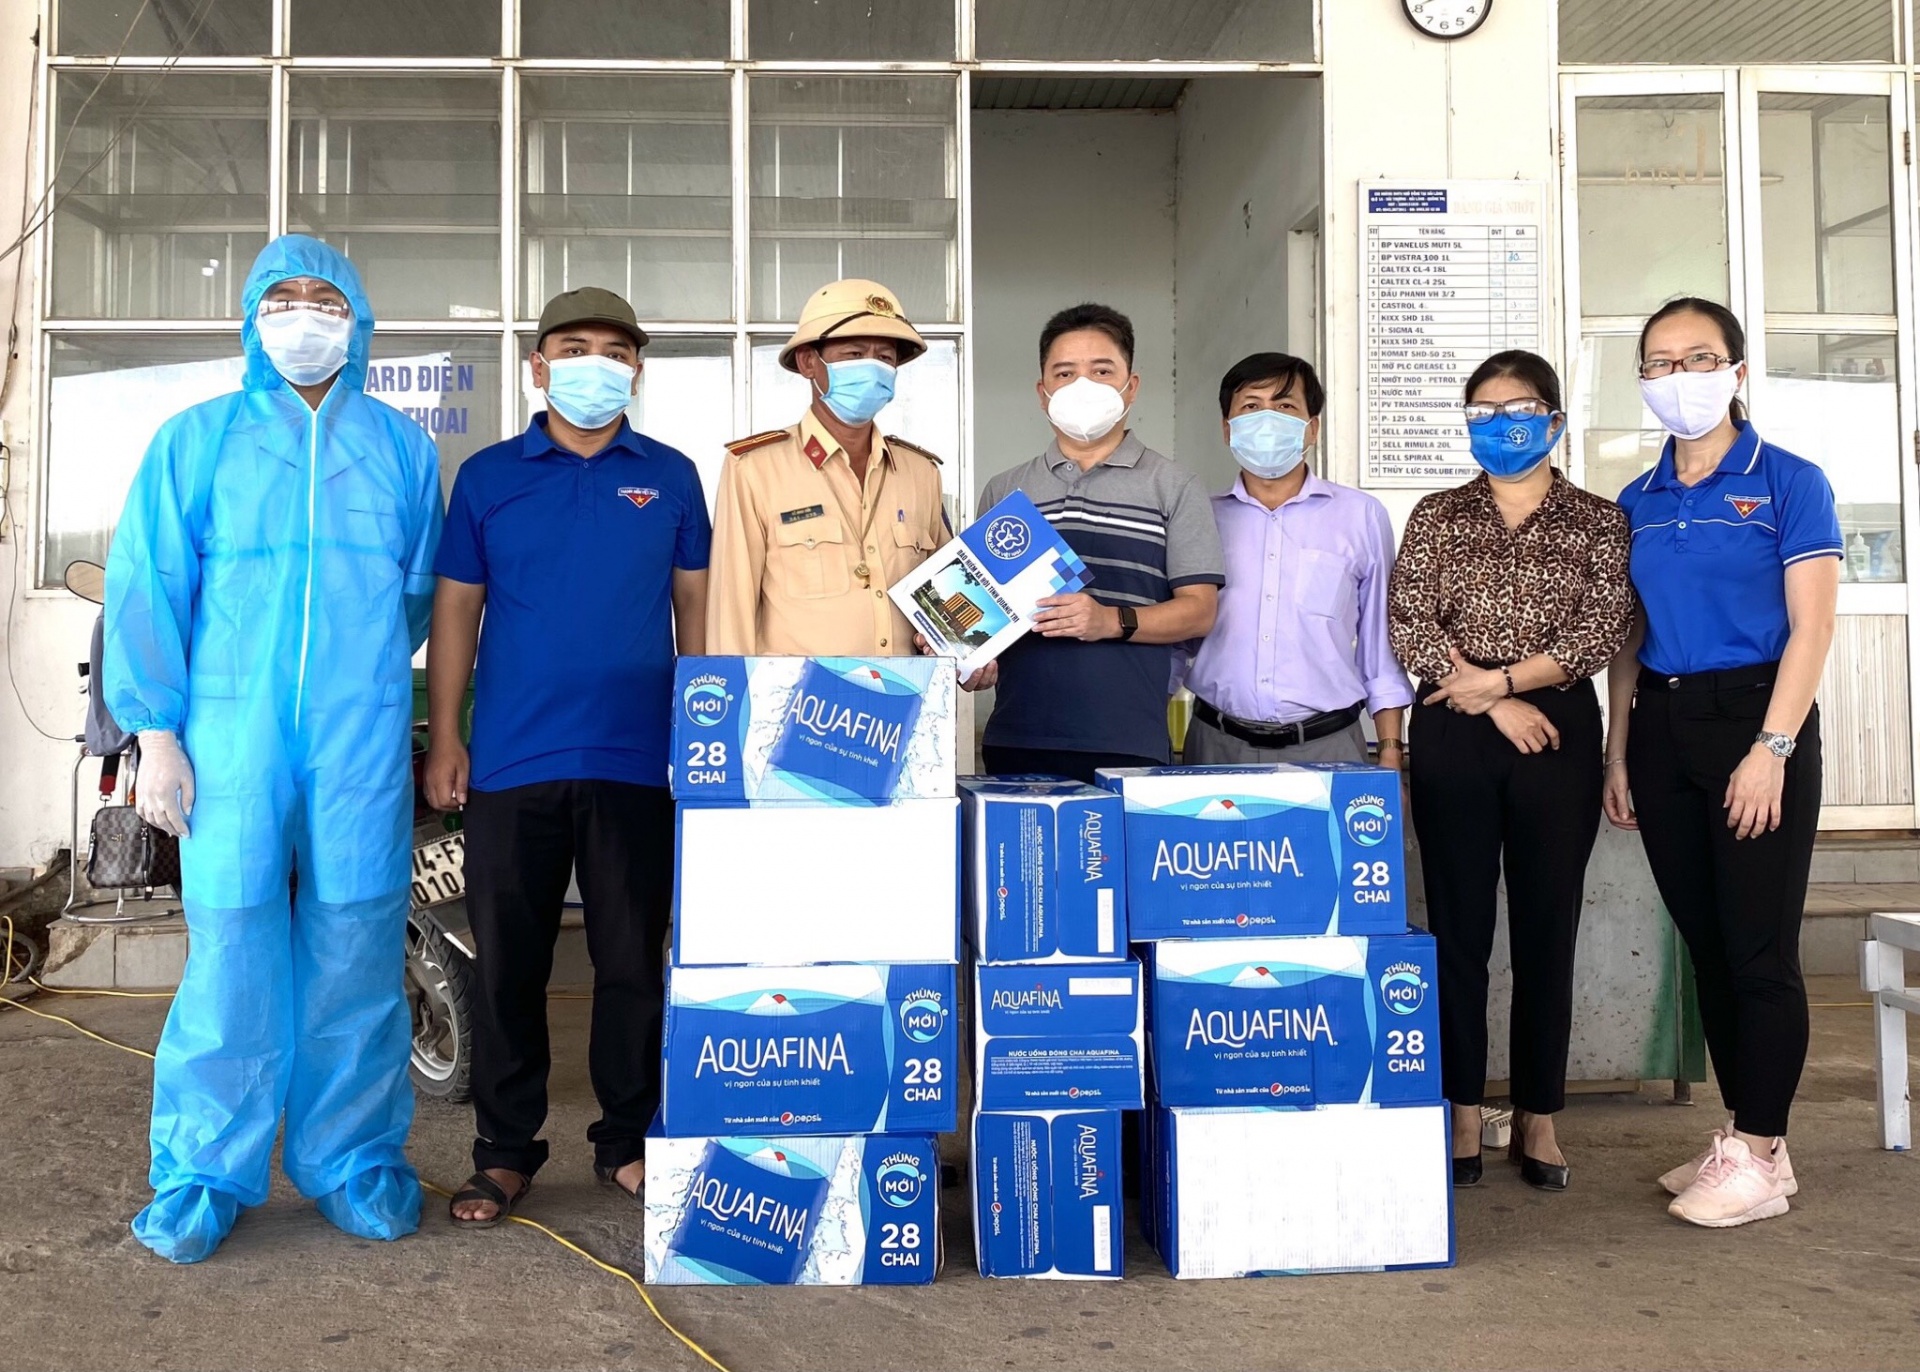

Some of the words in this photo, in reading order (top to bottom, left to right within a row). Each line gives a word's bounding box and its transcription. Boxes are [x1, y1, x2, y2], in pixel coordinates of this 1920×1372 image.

[1414, 4, 1423, 13] 8
[1466, 6, 1475, 14] 4
[1425, 16, 1434, 24] 7
[1439, 21, 1449, 29] 6
[1455, 17, 1465, 26] 5
[366, 366, 412, 392] ARD
[690, 673, 727, 688] THÙNG
[692, 698, 721, 712] MỚI
[784, 689, 903, 763] AQUAFINA
[687, 741, 727, 766] 28
[688, 770, 726, 784] CHAI
[1349, 792, 1385, 808] THÙNG
[1353, 819, 1381, 832] MỚI
[1083, 809, 1103, 883] AQUAFINA
[1152, 836, 1304, 881] AQUAFINA
[1352, 861, 1390, 887] 28
[1189, 883, 1209, 891] ngon
[1211, 881, 1225, 890] của
[1354, 890, 1390, 904] CHAI
[1249, 915, 1276, 925] pepsi
[1385, 960, 1422, 976] THÙNG
[905, 987, 942, 1004] THÙNG
[991, 989, 1063, 1010] AQUAFINA
[1389, 986, 1417, 1000] MỚI
[908, 1014, 936, 1028] MỚI
[1185, 1004, 1338, 1050] AQUAFINA
[1386, 1030, 1425, 1055] 28
[695, 1033, 854, 1078] AQUAFINA
[1223, 1052, 1243, 1060] ngon
[1245, 1050, 1259, 1058] của
[903, 1058, 942, 1084] 28
[1388, 1058, 1425, 1073] CHAI
[756, 1078, 771, 1087] của
[1283, 1084, 1310, 1094] pepsi
[903, 1088, 941, 1102] CHAI
[794, 1114, 821, 1123] pepsi
[882, 1151, 920, 1167] THÙNG
[1077, 1123, 1099, 1201] AQUAFINA
[885, 1178, 914, 1193] MỚI
[685, 1171, 808, 1250] AQUAFINA
[707, 1221, 725, 1233] ngon
[726, 1228, 741, 1239] của
[880, 1223, 920, 1249] 28
[880, 1253, 920, 1267] CHAI
